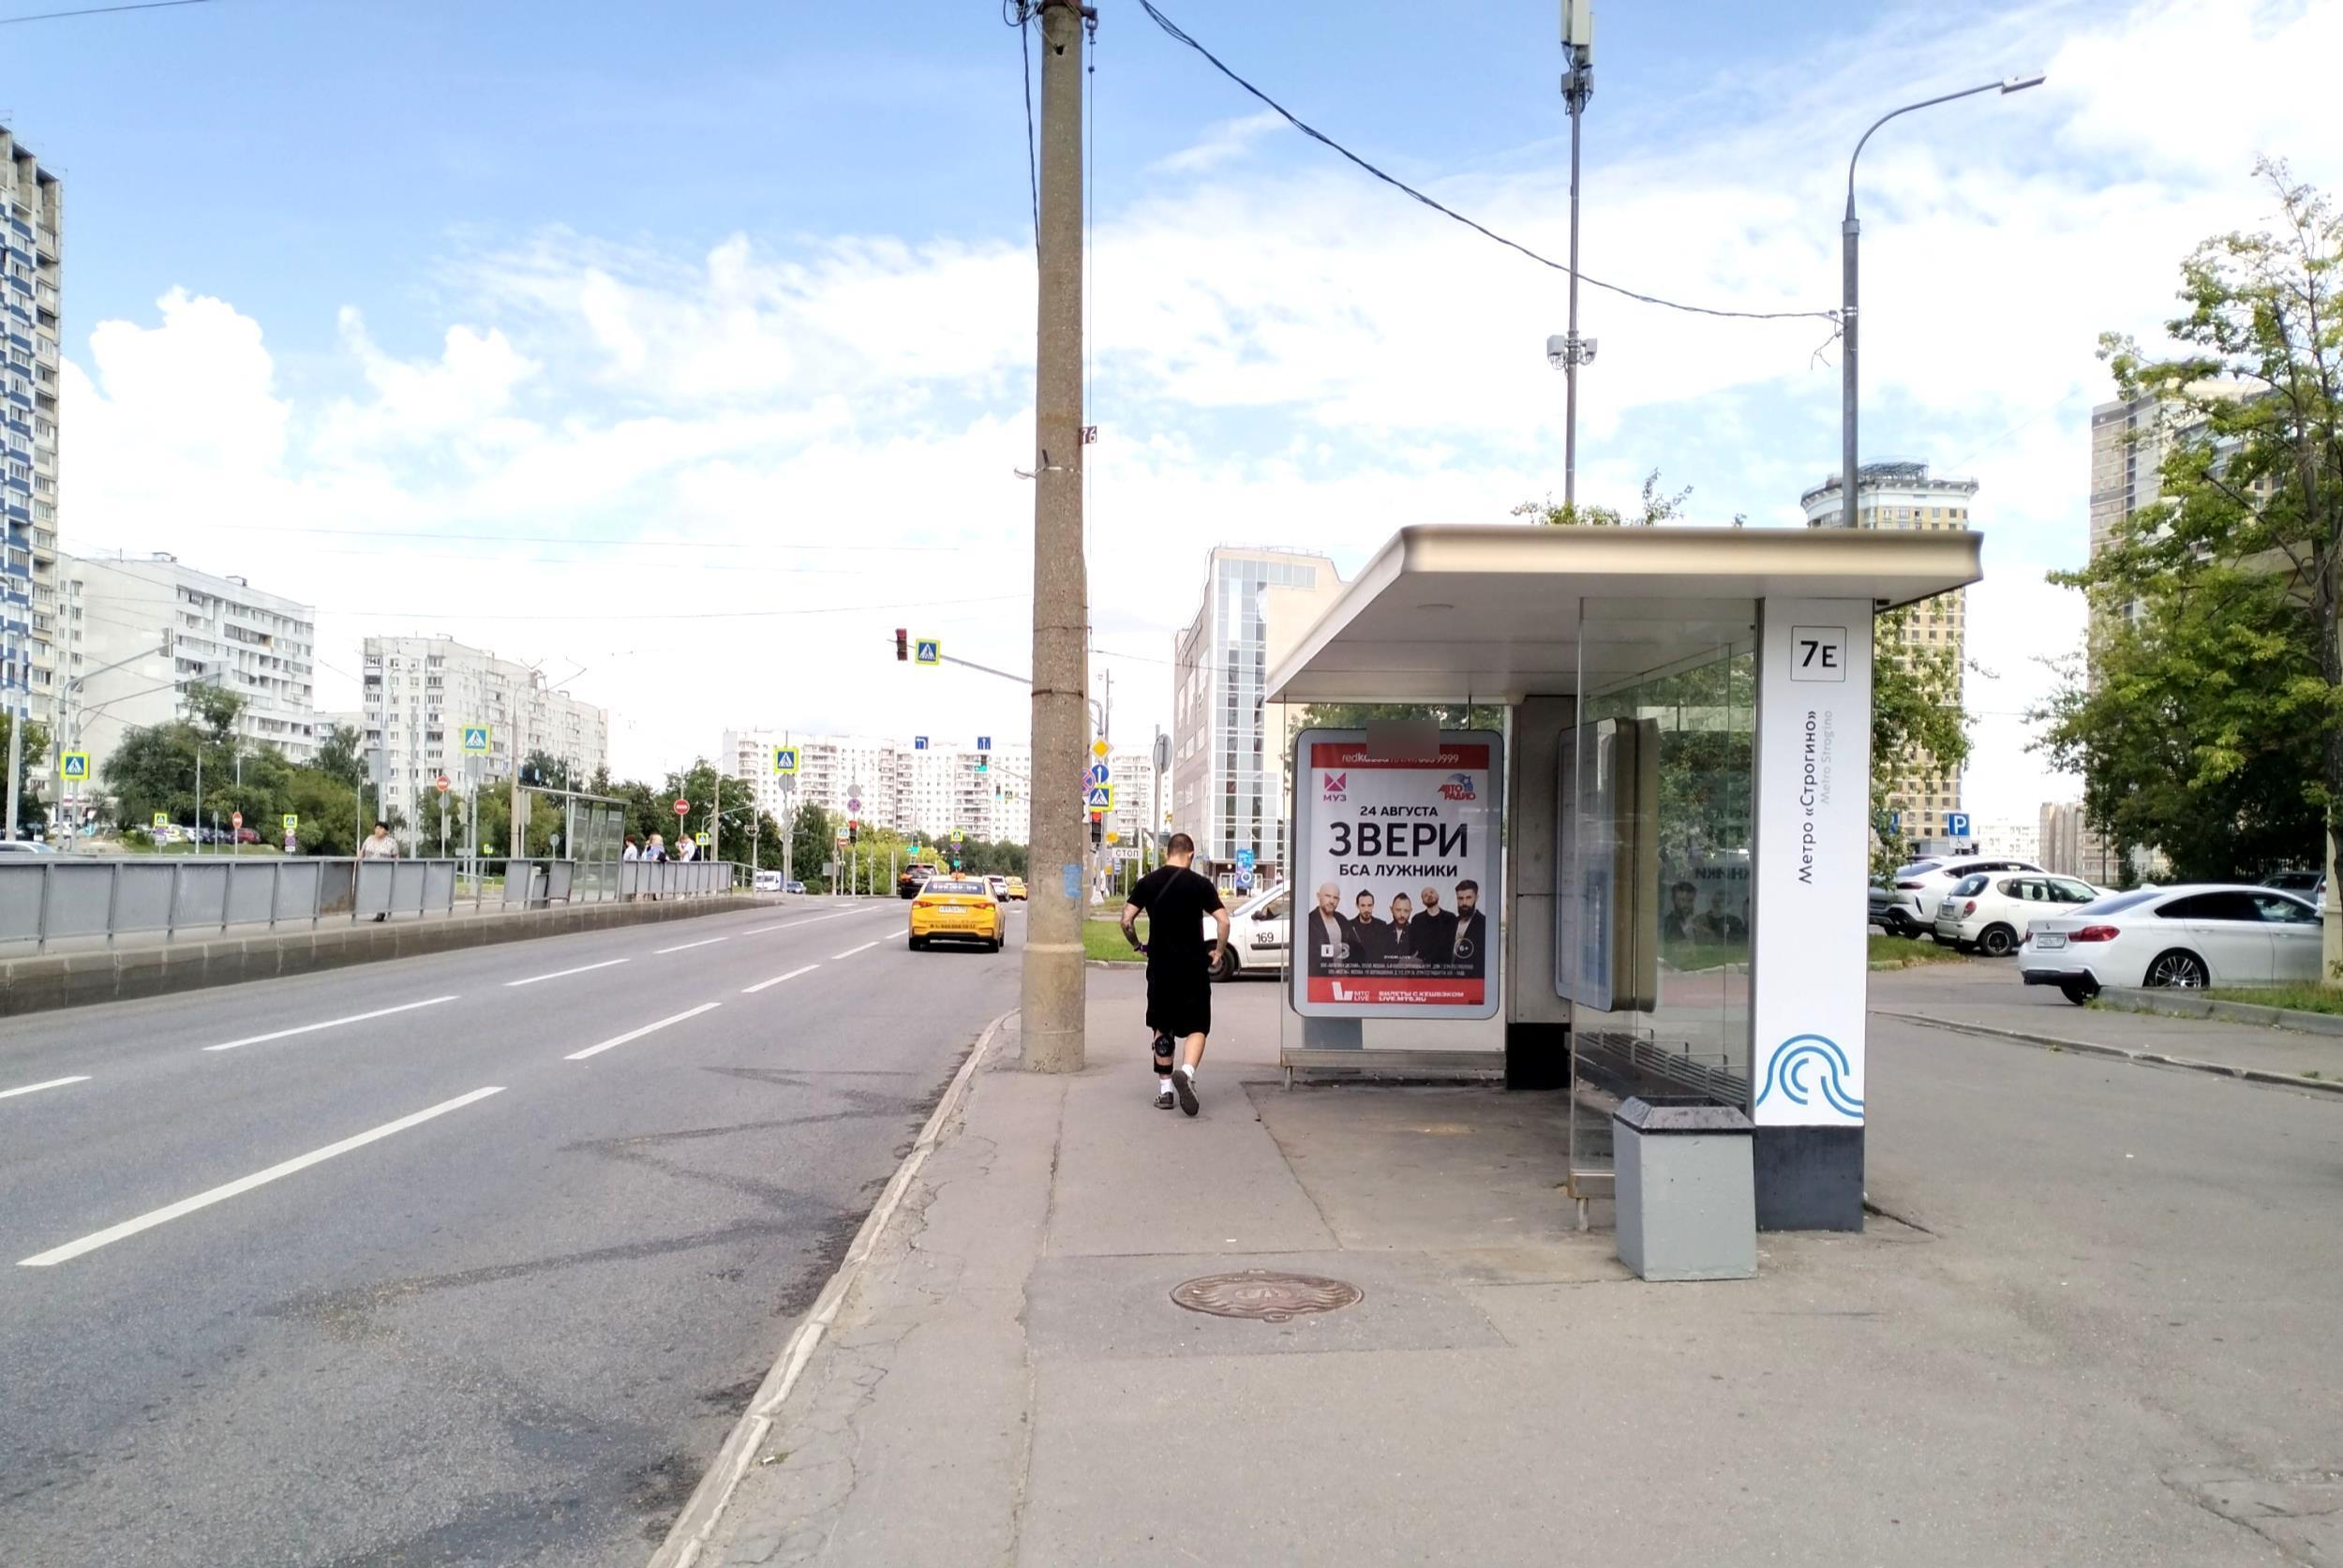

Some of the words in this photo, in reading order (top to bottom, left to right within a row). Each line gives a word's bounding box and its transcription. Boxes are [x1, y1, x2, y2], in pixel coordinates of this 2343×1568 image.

[1820, 709, 1835, 764] Strogino
[1799, 710, 1818, 816] «Строгино»
[1322, 794, 1347, 802] МУЗ
[1820, 766, 1831, 805] Metro
[1360, 806, 1377, 816] 24
[1380, 806, 1439, 817] АВГУСТА
[1328, 821, 1469, 858] ЗВЕРИ
[1115, 848, 1139, 858] СТОП
[1798, 821, 1816, 885] Метро
[1338, 863, 1370, 876] БСА
[1375, 864, 1458, 877] ЛУЖНИКИ
[1256, 932, 1275, 944] 169
